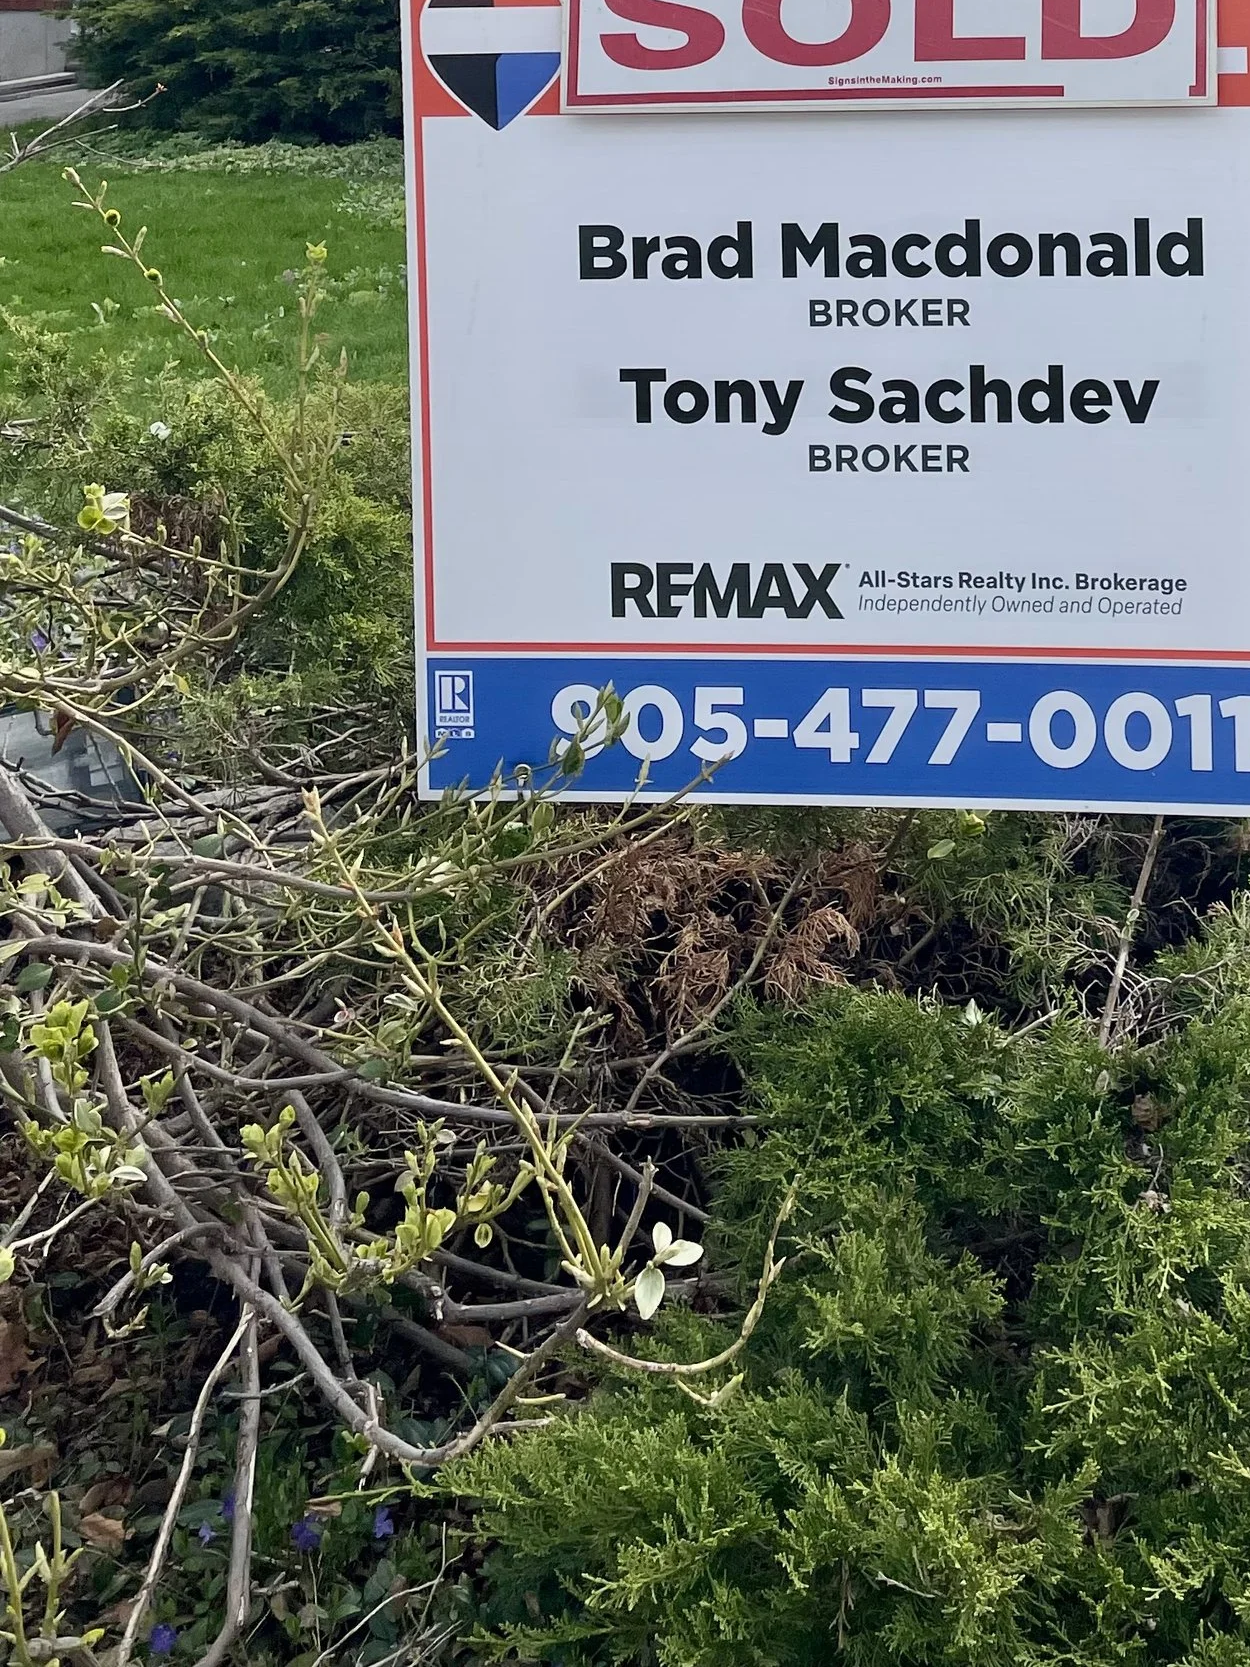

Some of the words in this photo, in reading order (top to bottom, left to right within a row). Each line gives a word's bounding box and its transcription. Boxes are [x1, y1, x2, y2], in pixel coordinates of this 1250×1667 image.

[578, 221, 753, 280] Brad
[780, 218, 1204, 278] Macdonald
[808, 298, 971, 327] BROKER
[619, 368, 804, 435] Tony
[828, 365, 1160, 424] Sachdev
[808, 444, 970, 473] BROKER
[858, 570, 953, 589] All-Stars
[958, 571, 1026, 593] Realty
[1031, 572, 1070, 590] Inc.
[1075, 573, 1188, 595] Brokerage
[858, 594, 987, 615] Independently
[991, 595, 1055, 614] Owned
[1059, 596, 1093, 614] and
[1098, 597, 1183, 617] Operated
[439, 715, 470, 723] REALTOR
